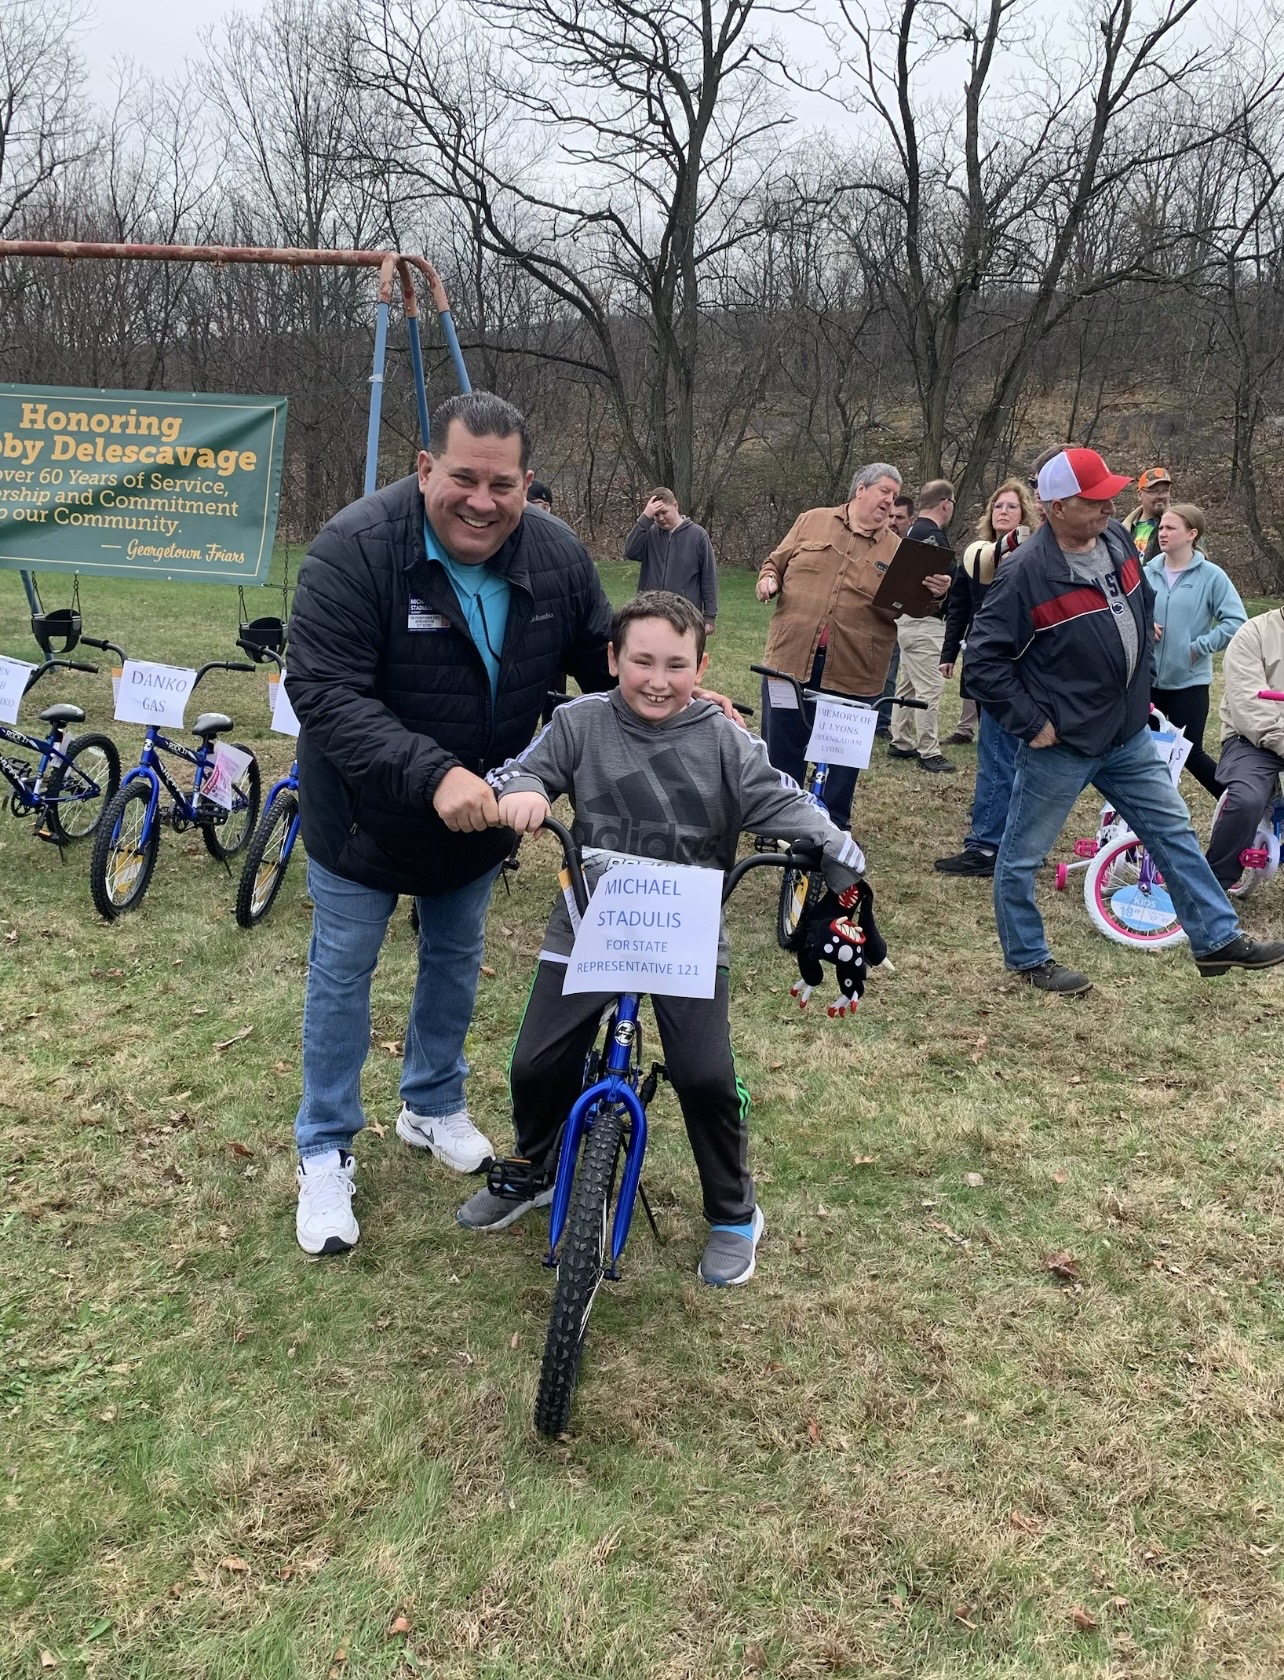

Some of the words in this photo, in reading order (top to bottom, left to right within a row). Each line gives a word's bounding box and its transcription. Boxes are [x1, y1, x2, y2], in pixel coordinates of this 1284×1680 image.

[20, 403, 182, 442] Honoring
[0, 432, 44, 465] by
[51, 435, 257, 476] Delescavage
[39, 468, 63, 484] 60
[69, 470, 117, 486] Years
[123, 472, 144, 489] of
[151, 473, 229, 497] Service,
[0, 486, 50, 505] rship
[55, 489, 93, 505] and
[100, 491, 238, 516] Commitment
[13, 508, 48, 522] our
[54, 508, 182, 537] Community.
[127, 539, 201, 562] Georgetown
[206, 543, 245, 563] Friars
[131, 670, 187, 692] DANKO
[142, 697, 166, 713] GAS
[829, 723, 860, 735] LYONS
[860, 715, 874, 725] OF
[604, 878, 682, 896] MICHAEL
[597, 911, 682, 928] STADULIS
[606, 939, 630, 951] FOR
[633, 940, 668, 953] STATE
[577, 961, 673, 975] REPRESENTATIVE
[677, 964, 699, 976] 121
